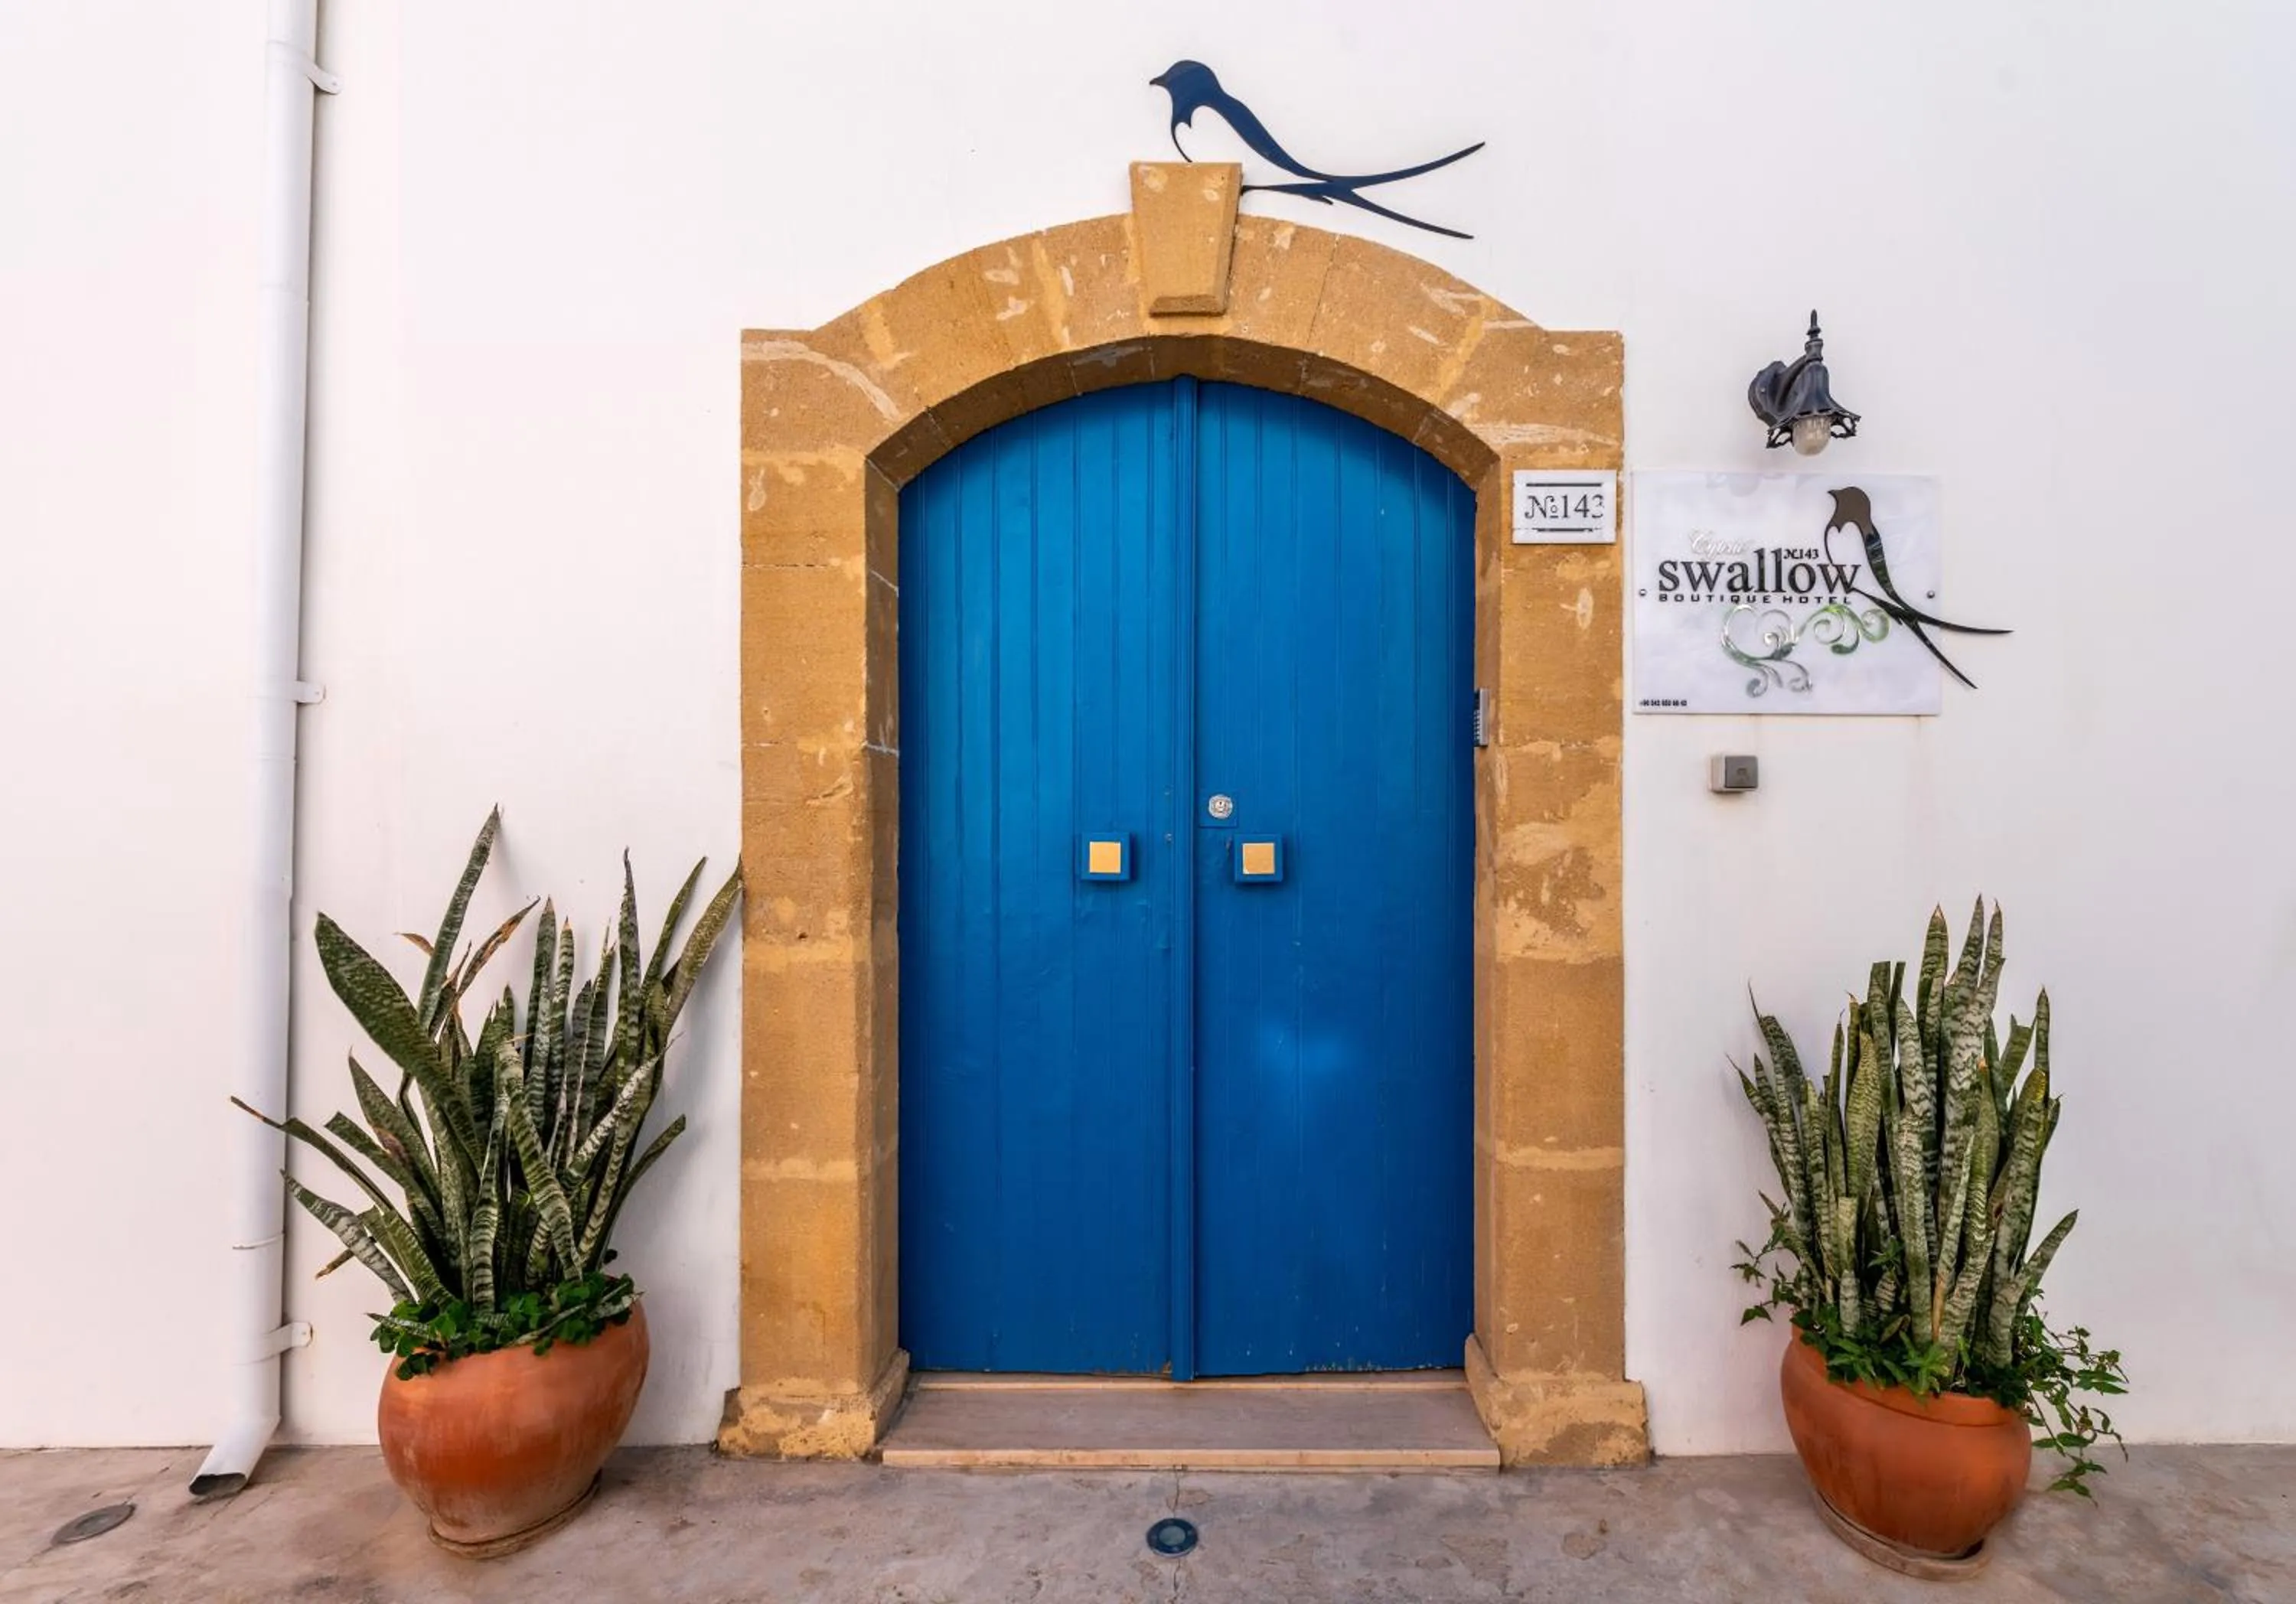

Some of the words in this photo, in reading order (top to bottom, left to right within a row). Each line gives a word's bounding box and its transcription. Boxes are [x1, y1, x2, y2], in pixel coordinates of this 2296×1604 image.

[1658, 547, 1862, 595] swallow
[1658, 594, 1772, 604] BOUTIQUE
[1782, 596, 1852, 605] HOTEL
